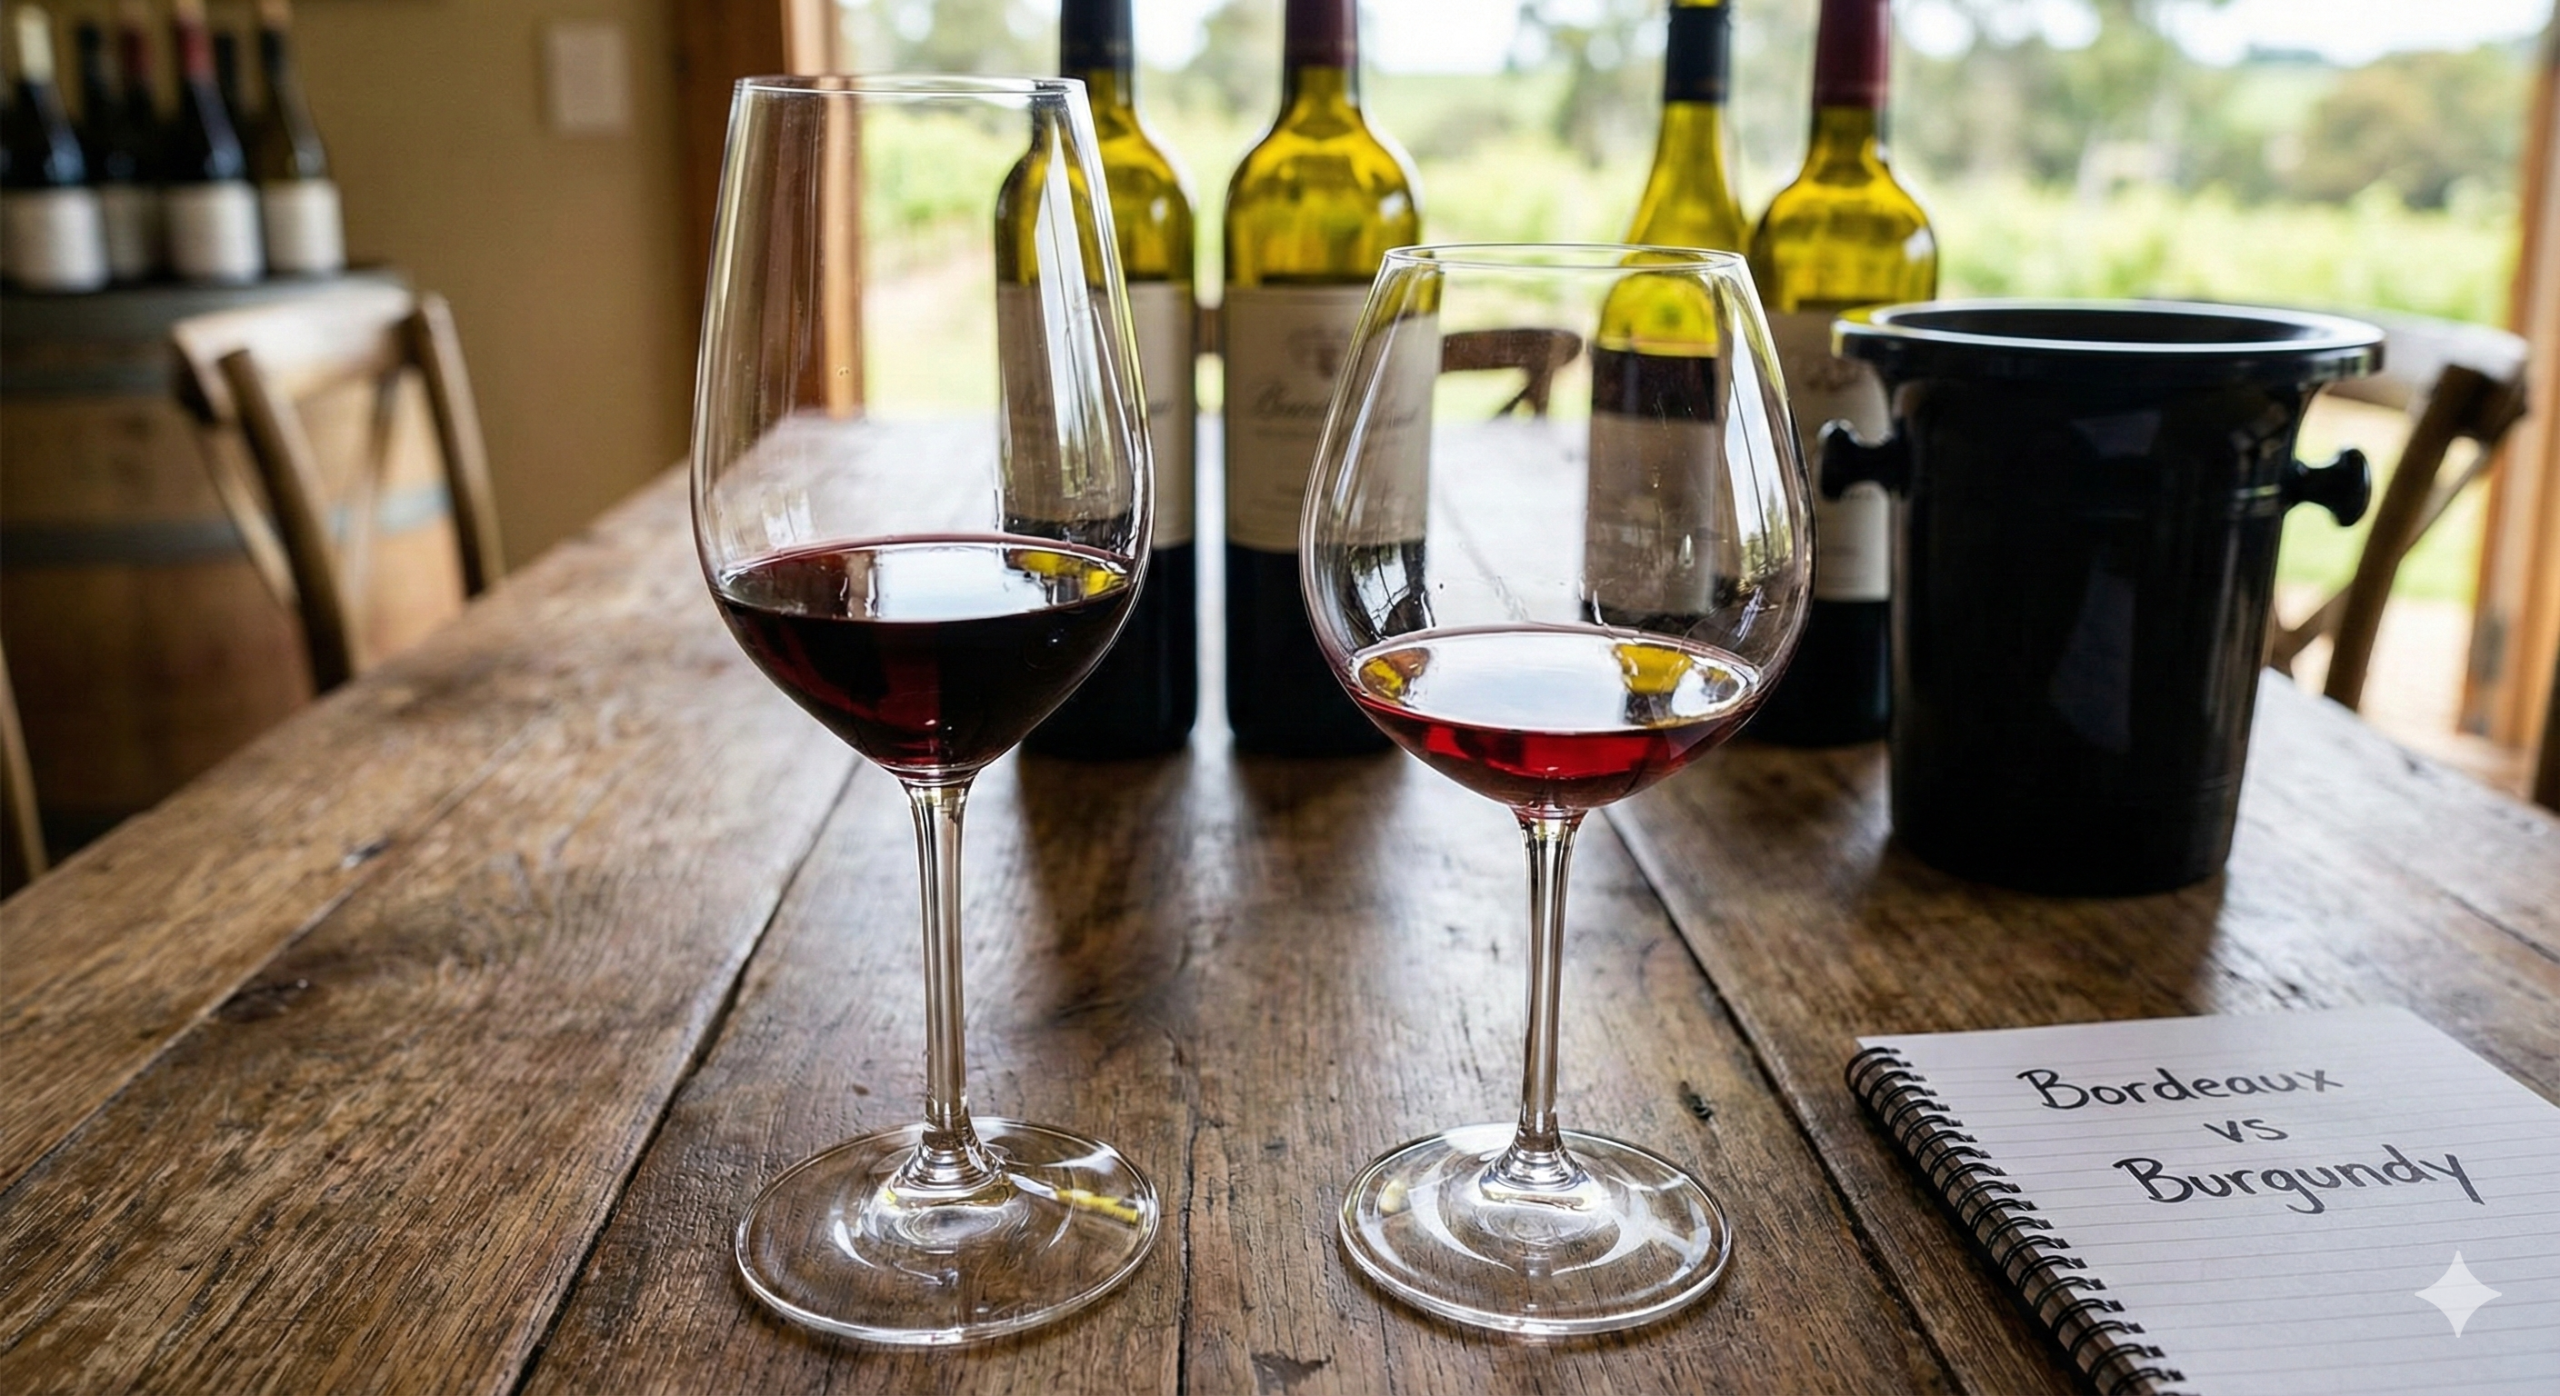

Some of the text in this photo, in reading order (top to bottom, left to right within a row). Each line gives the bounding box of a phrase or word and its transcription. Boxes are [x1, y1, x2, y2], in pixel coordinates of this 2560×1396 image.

[2017, 1068, 2343, 1110] Bordeaux
[2203, 1118, 2289, 1143] vs
[2114, 1144, 2485, 1215] Burgundy
